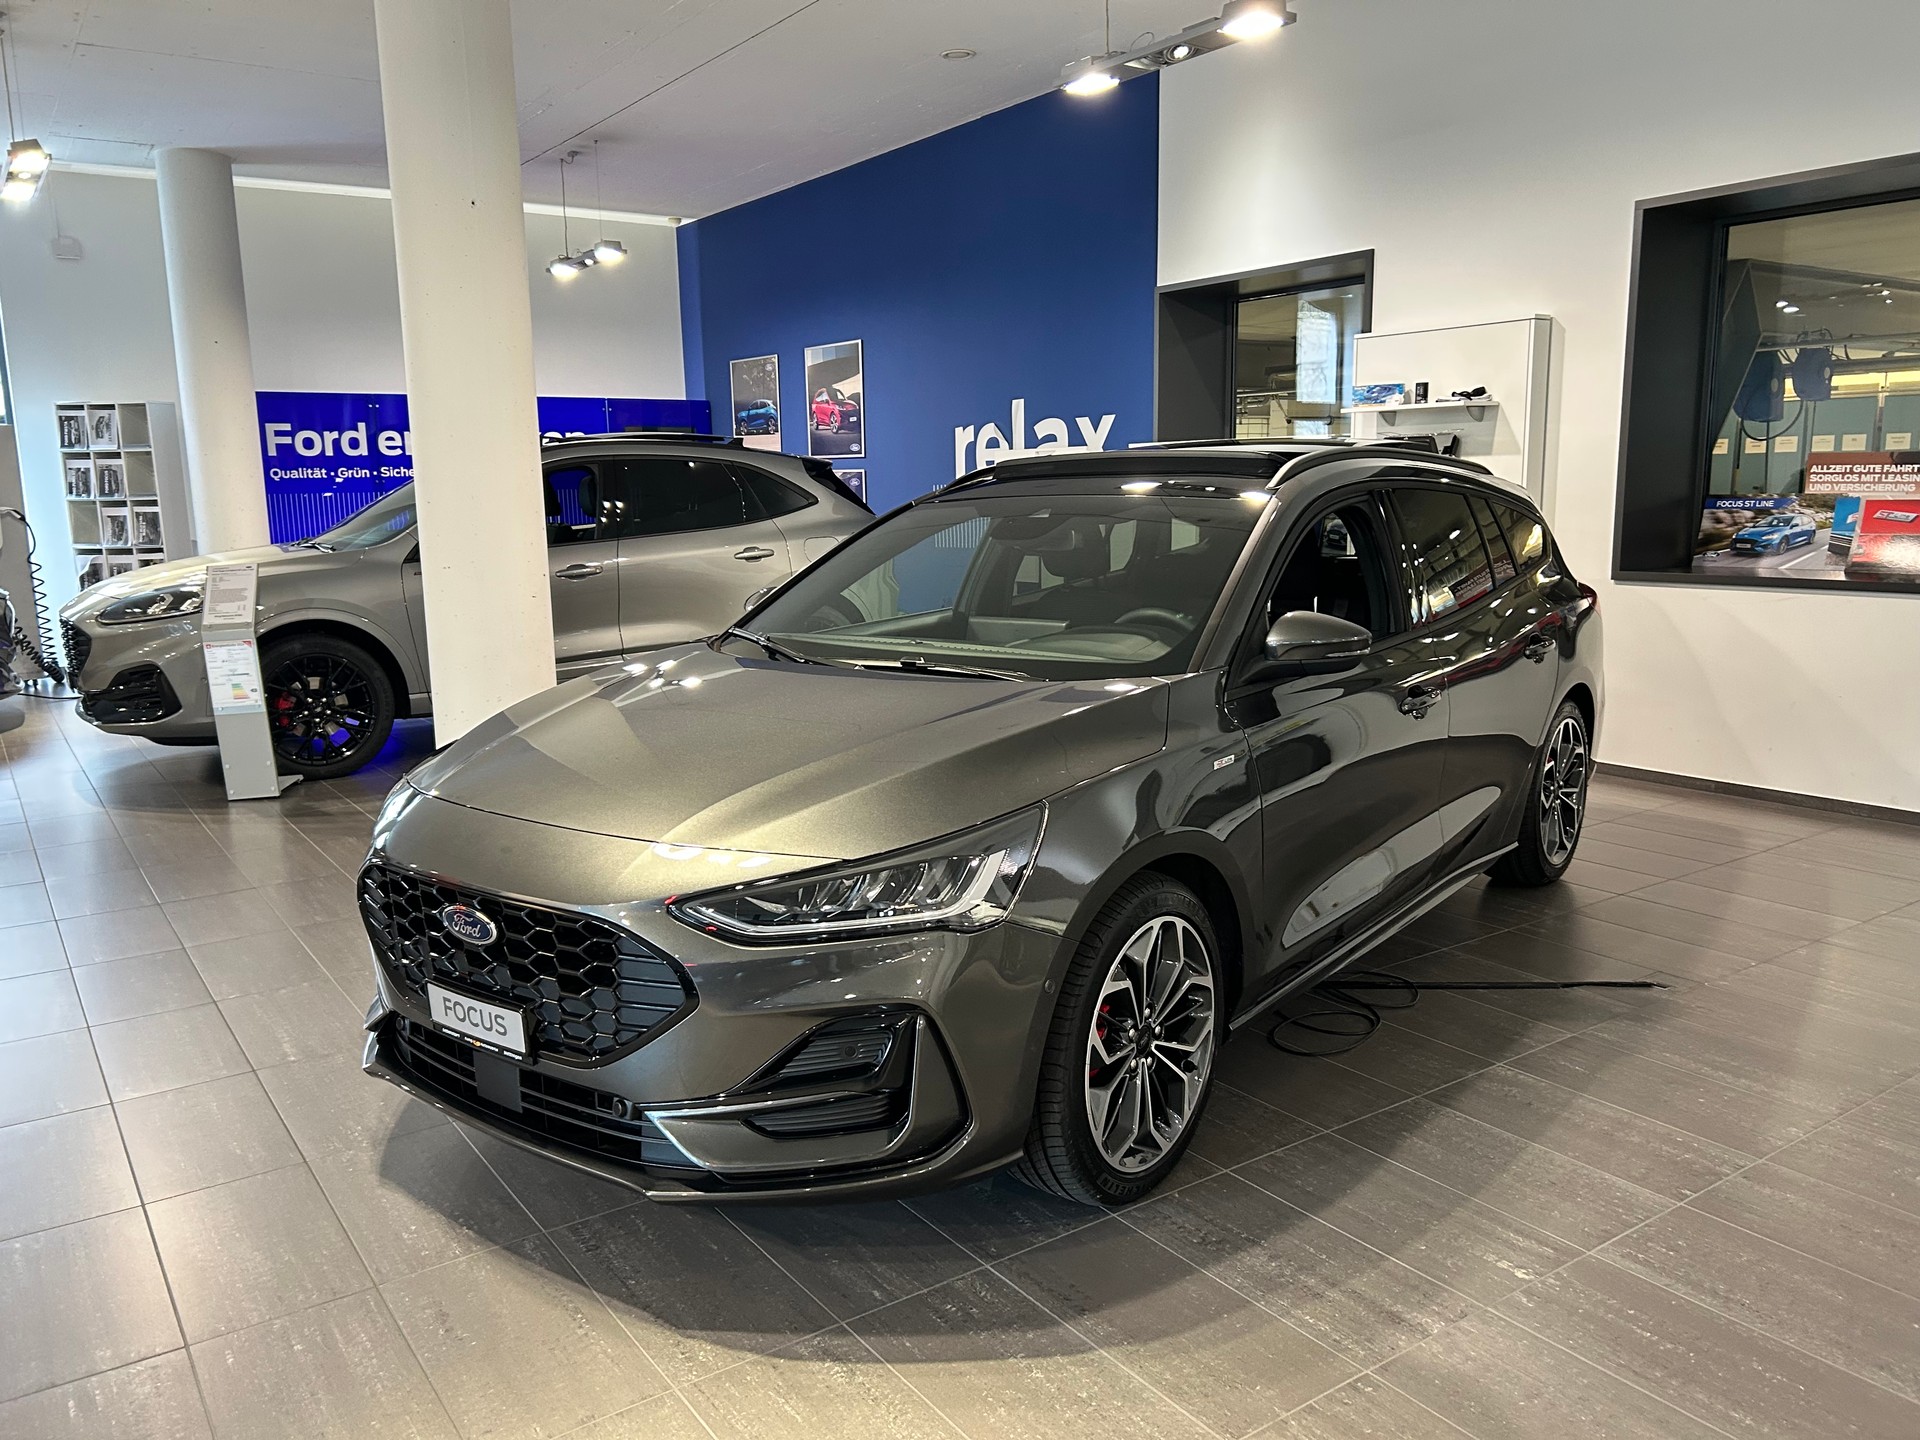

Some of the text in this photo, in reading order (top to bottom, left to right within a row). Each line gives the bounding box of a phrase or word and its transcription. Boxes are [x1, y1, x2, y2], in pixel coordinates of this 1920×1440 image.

[265, 422, 369, 457] Ford
[954, 398, 1116, 480] relax
[270, 468, 327, 480] Qualität
[338, 467, 370, 478] Grün
[1810, 464, 1919, 473] ALLZEIT GUTE FAHRT
[1809, 474, 1920, 482] SORGLOS MIT LEASIN
[1809, 483, 1916, 492] UND VERSICHERUNG
[1716, 500, 1775, 508] FOCUS ST LINE
[452, 913, 482, 938] Ford
[442, 996, 508, 1037] FOCUS
